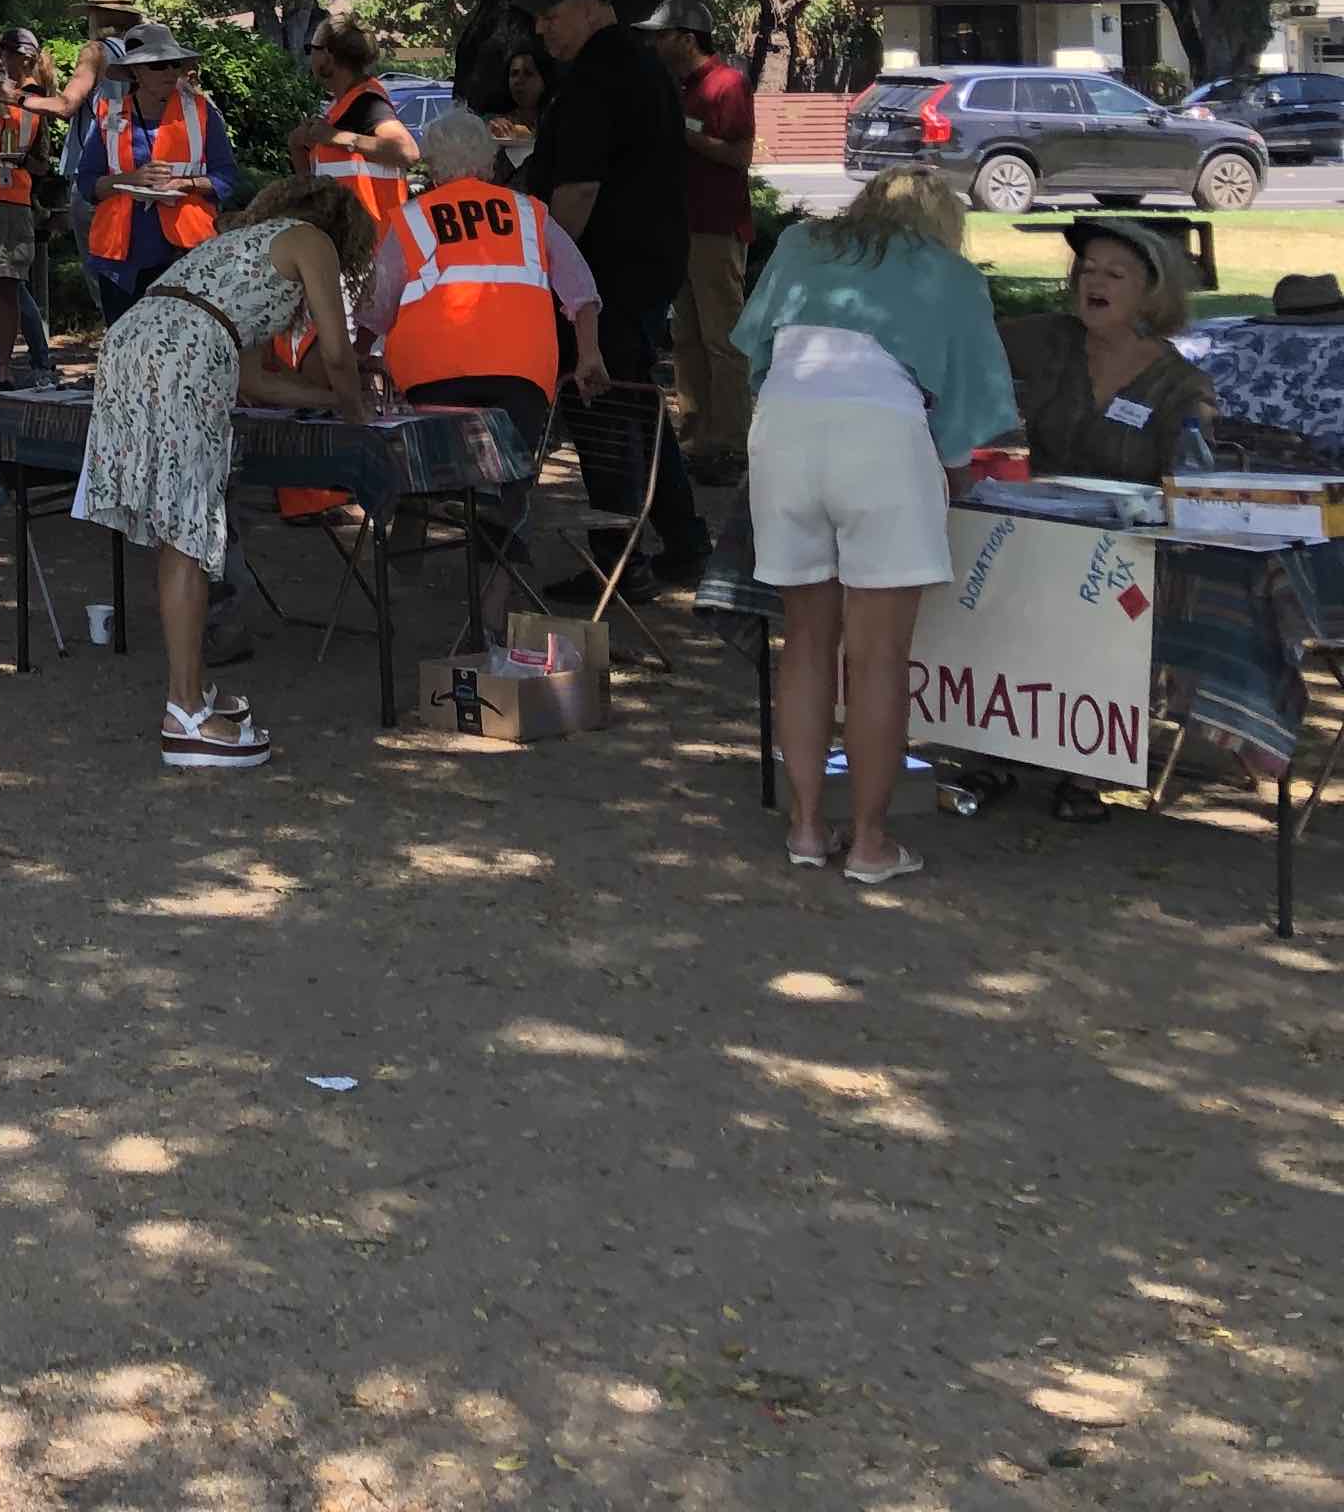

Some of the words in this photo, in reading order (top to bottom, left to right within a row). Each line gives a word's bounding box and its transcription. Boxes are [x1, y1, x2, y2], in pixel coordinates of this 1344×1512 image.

[430, 198, 514, 245] BPC
[959, 516, 1016, 611] DONATIONS
[1107, 555, 1135, 590] TIX
[909, 659, 1141, 765] RMATION
